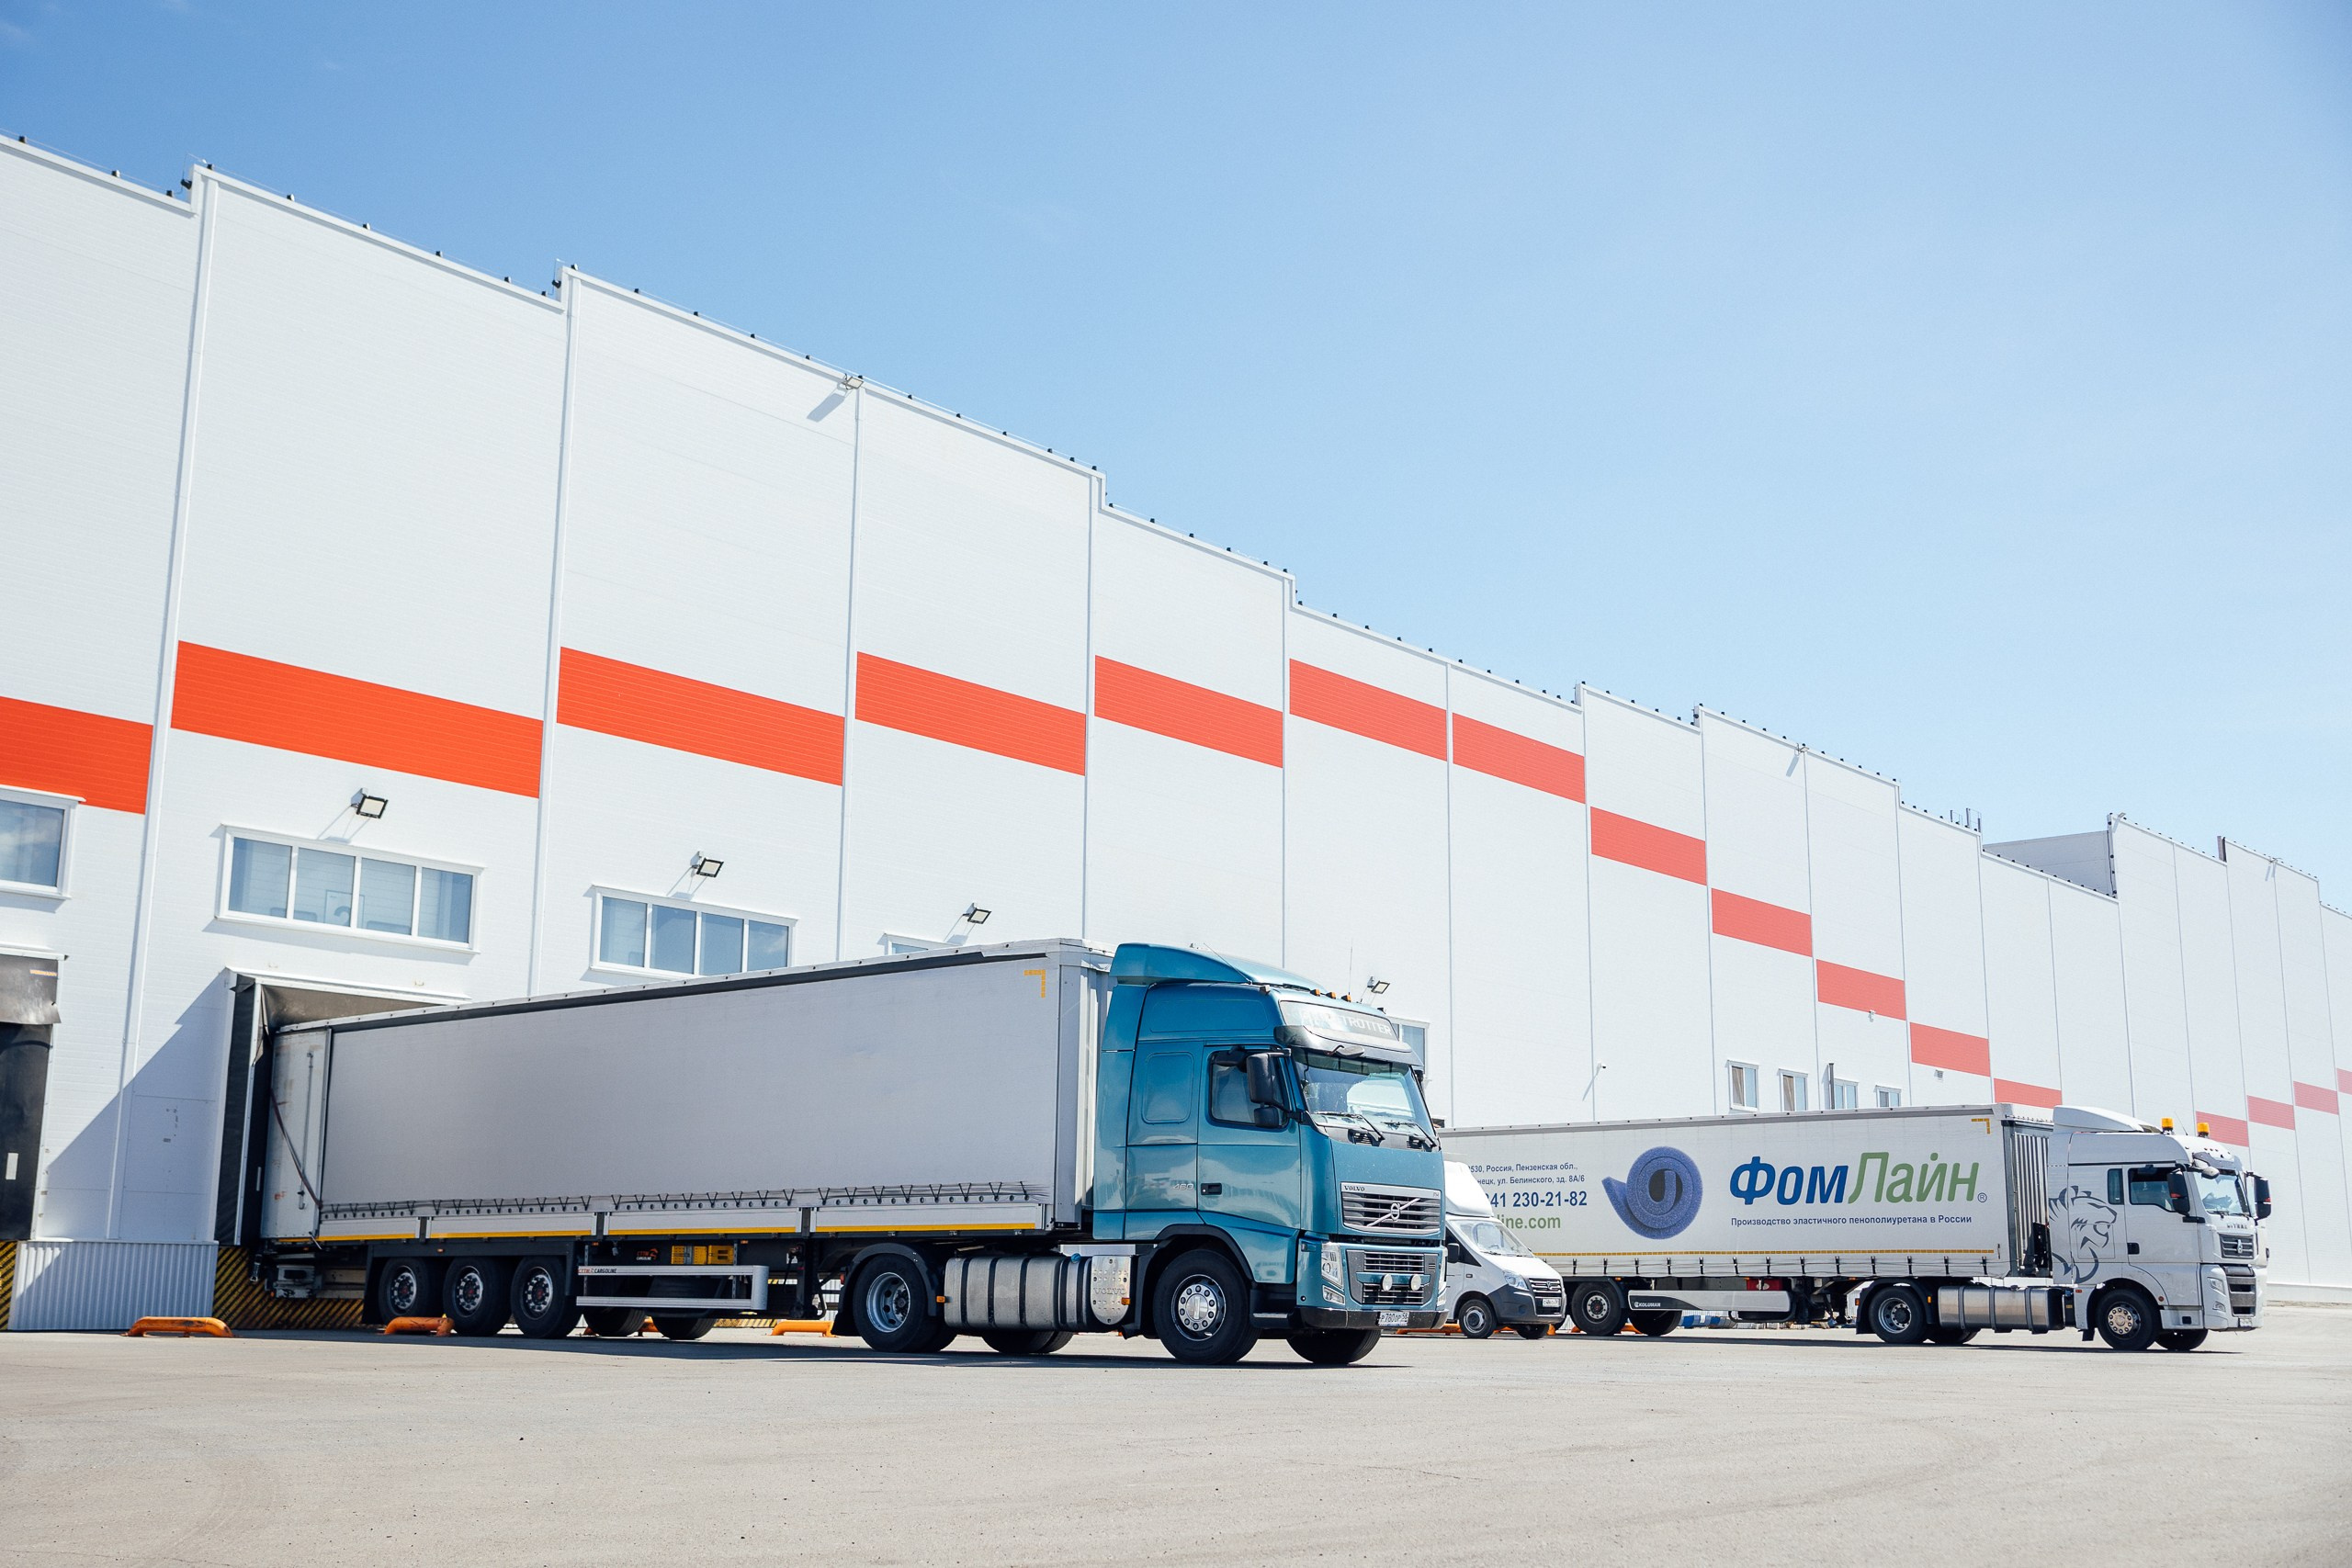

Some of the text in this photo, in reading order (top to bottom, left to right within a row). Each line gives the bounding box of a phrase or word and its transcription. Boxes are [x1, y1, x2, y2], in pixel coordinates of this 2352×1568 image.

[1516, 1163, 1558, 1171] Пензенская
[1559, 1162, 1578, 1171] обл.,
[1497, 1178, 1509, 1186] ул.
[1510, 1176, 1555, 1184] Белинского,
[1485, 1190, 1588, 1208] 41 230-21-82
[1731, 1217, 1792, 1227] Производство
[1792, 1216, 1847, 1225] эластичного
[1849, 1215, 1928, 1224] пенополиуретана
[1938, 1214, 1973, 1224] России
